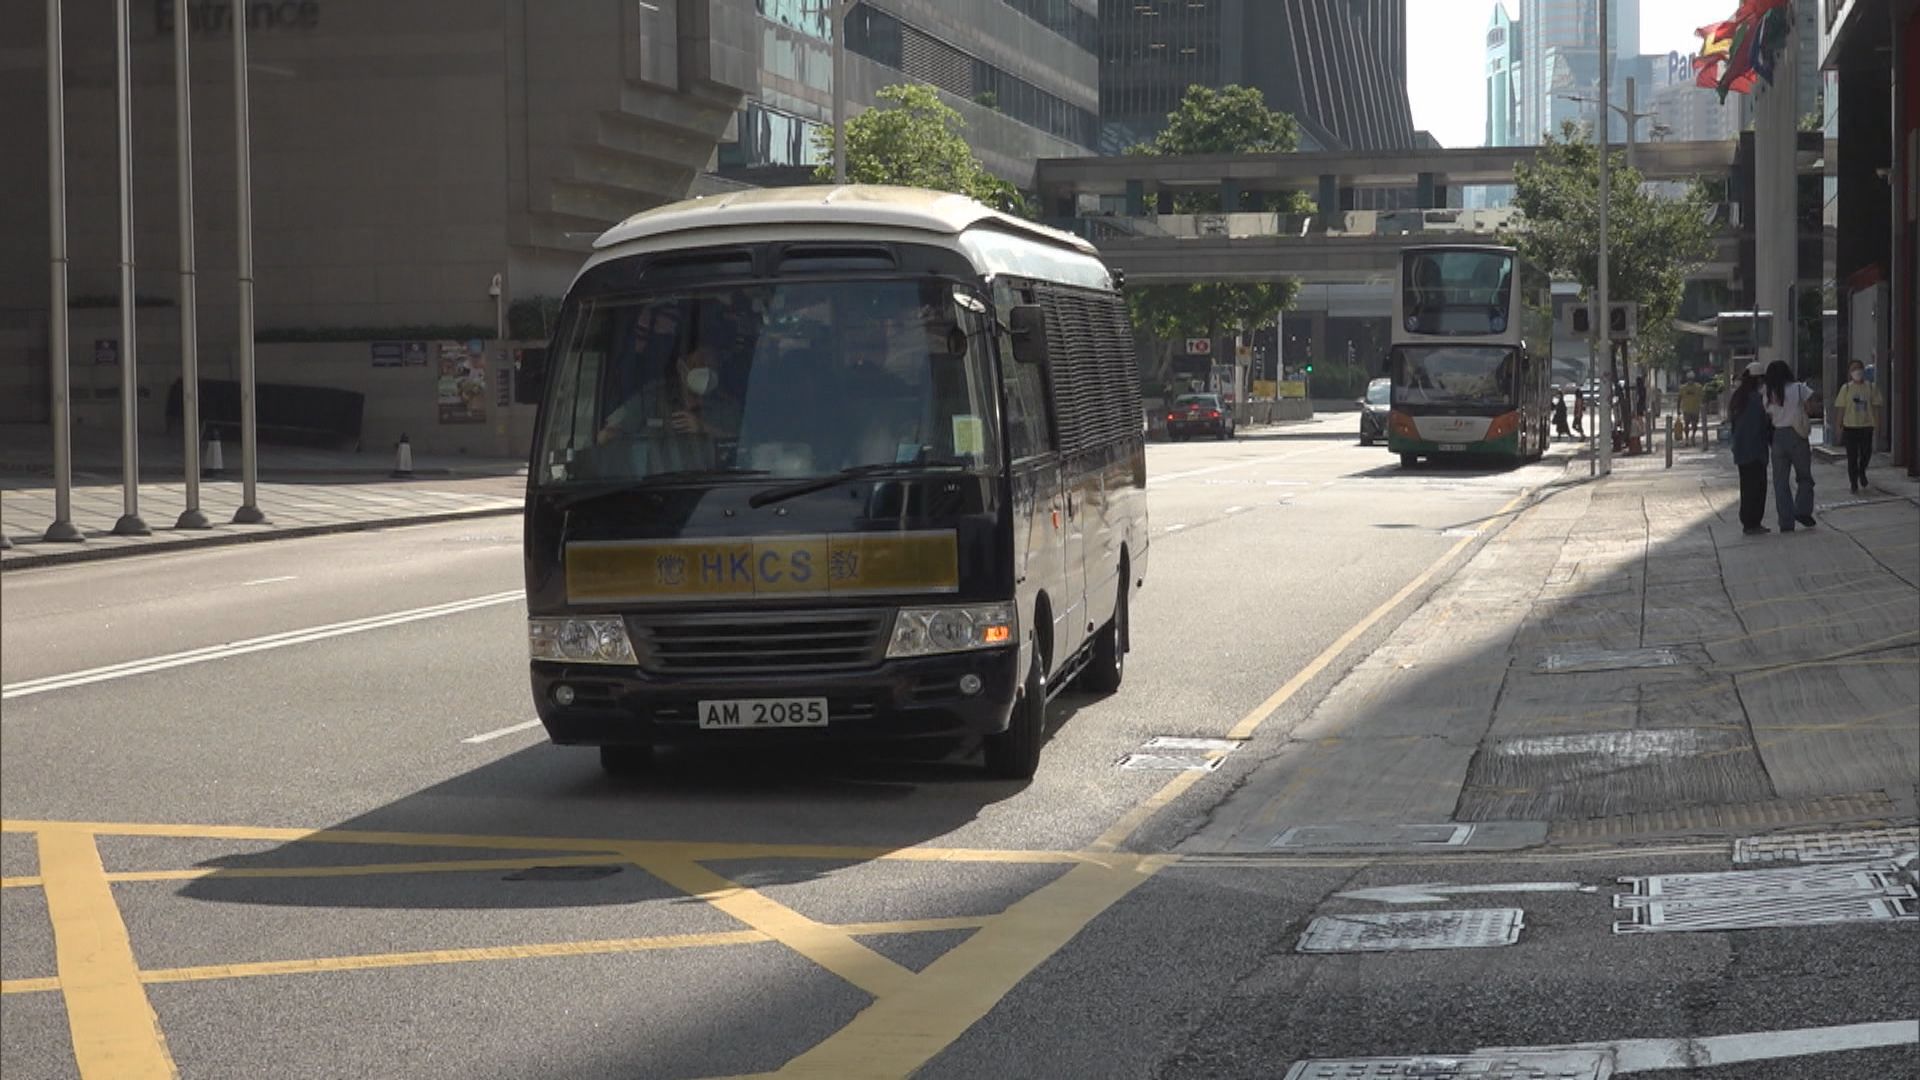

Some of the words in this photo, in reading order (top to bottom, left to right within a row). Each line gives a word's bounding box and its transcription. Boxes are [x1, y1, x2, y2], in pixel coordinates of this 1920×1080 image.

[700, 550, 812, 583] HKCS
[830, 549, 859, 581] 教
[705, 703, 740, 725] AM
[752, 702, 823, 724] 2085
